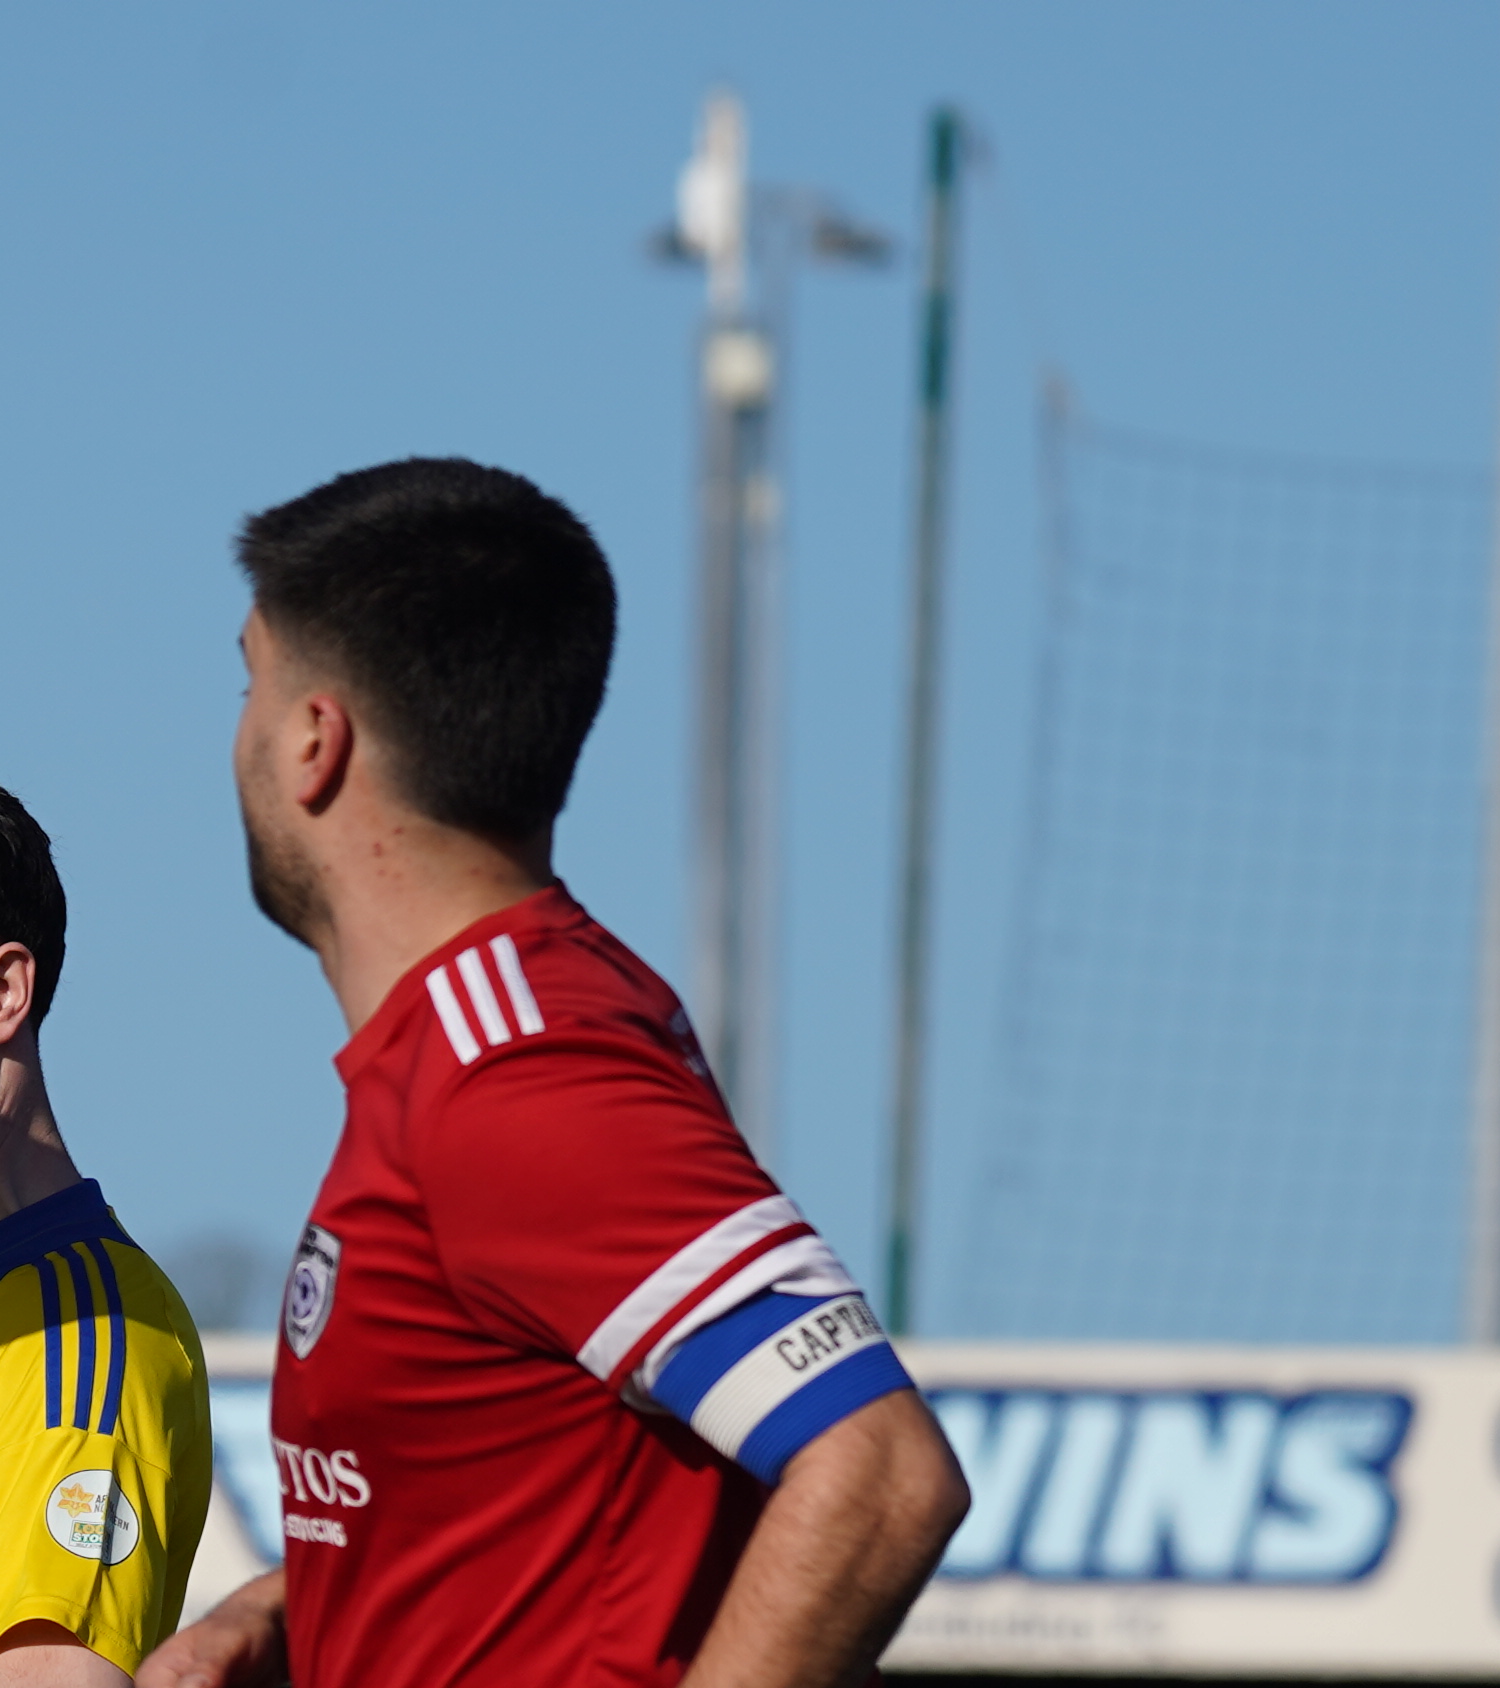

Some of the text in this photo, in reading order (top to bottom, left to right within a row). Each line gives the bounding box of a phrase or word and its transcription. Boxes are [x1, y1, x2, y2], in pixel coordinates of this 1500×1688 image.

[775, 1300, 883, 1372] CAPT
[73, 1521, 106, 1535] LOC
[71, 1532, 106, 1545] STO
